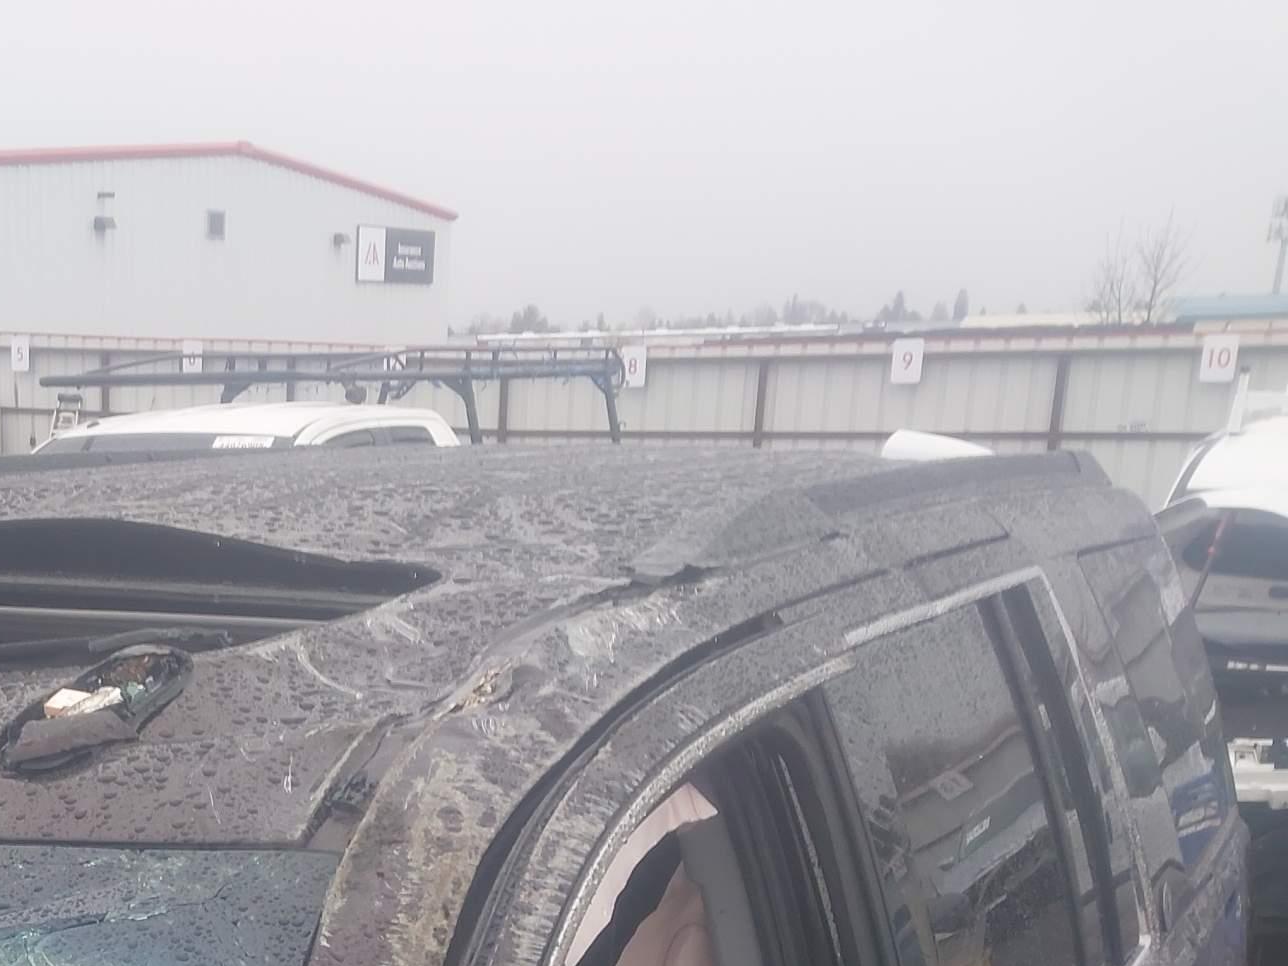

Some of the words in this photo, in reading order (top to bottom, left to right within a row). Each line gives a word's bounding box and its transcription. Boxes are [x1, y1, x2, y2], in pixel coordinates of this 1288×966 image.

[628, 358, 637, 375] 8
[903, 351, 913, 370] 9
[1208, 347, 1231, 369] 10
